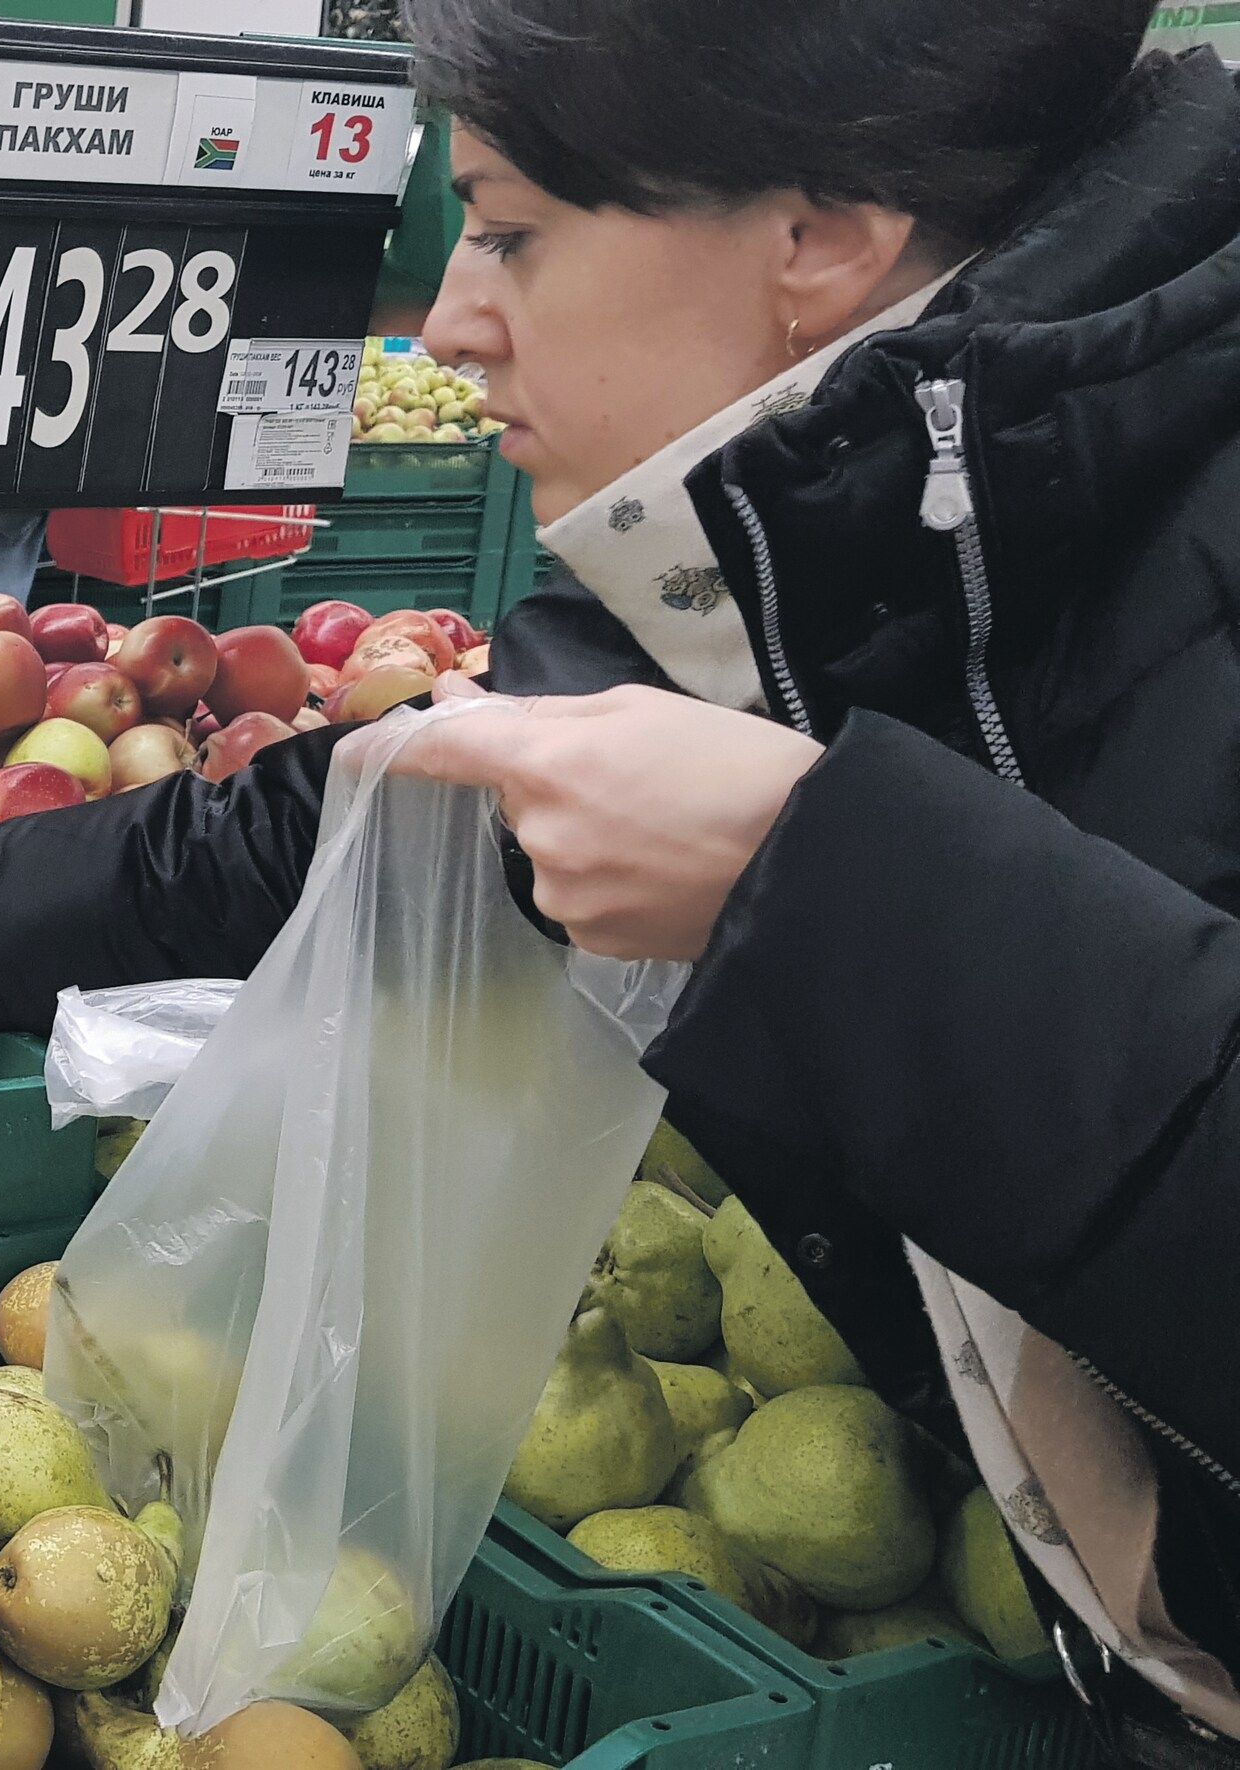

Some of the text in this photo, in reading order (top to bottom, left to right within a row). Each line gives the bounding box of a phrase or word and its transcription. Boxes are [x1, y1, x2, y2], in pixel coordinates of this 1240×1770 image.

[12, 80, 130, 114] ГРУШИ
[311, 91, 386, 109] КЛАВИША
[211, 127, 233, 138] ЮАР
[309, 112, 374, 164] 13
[309, 168, 356, 180] цена за кг
[106, 249, 237, 354] 28
[284, 349, 356, 397] 143 28
[337, 380, 355, 396] руб
